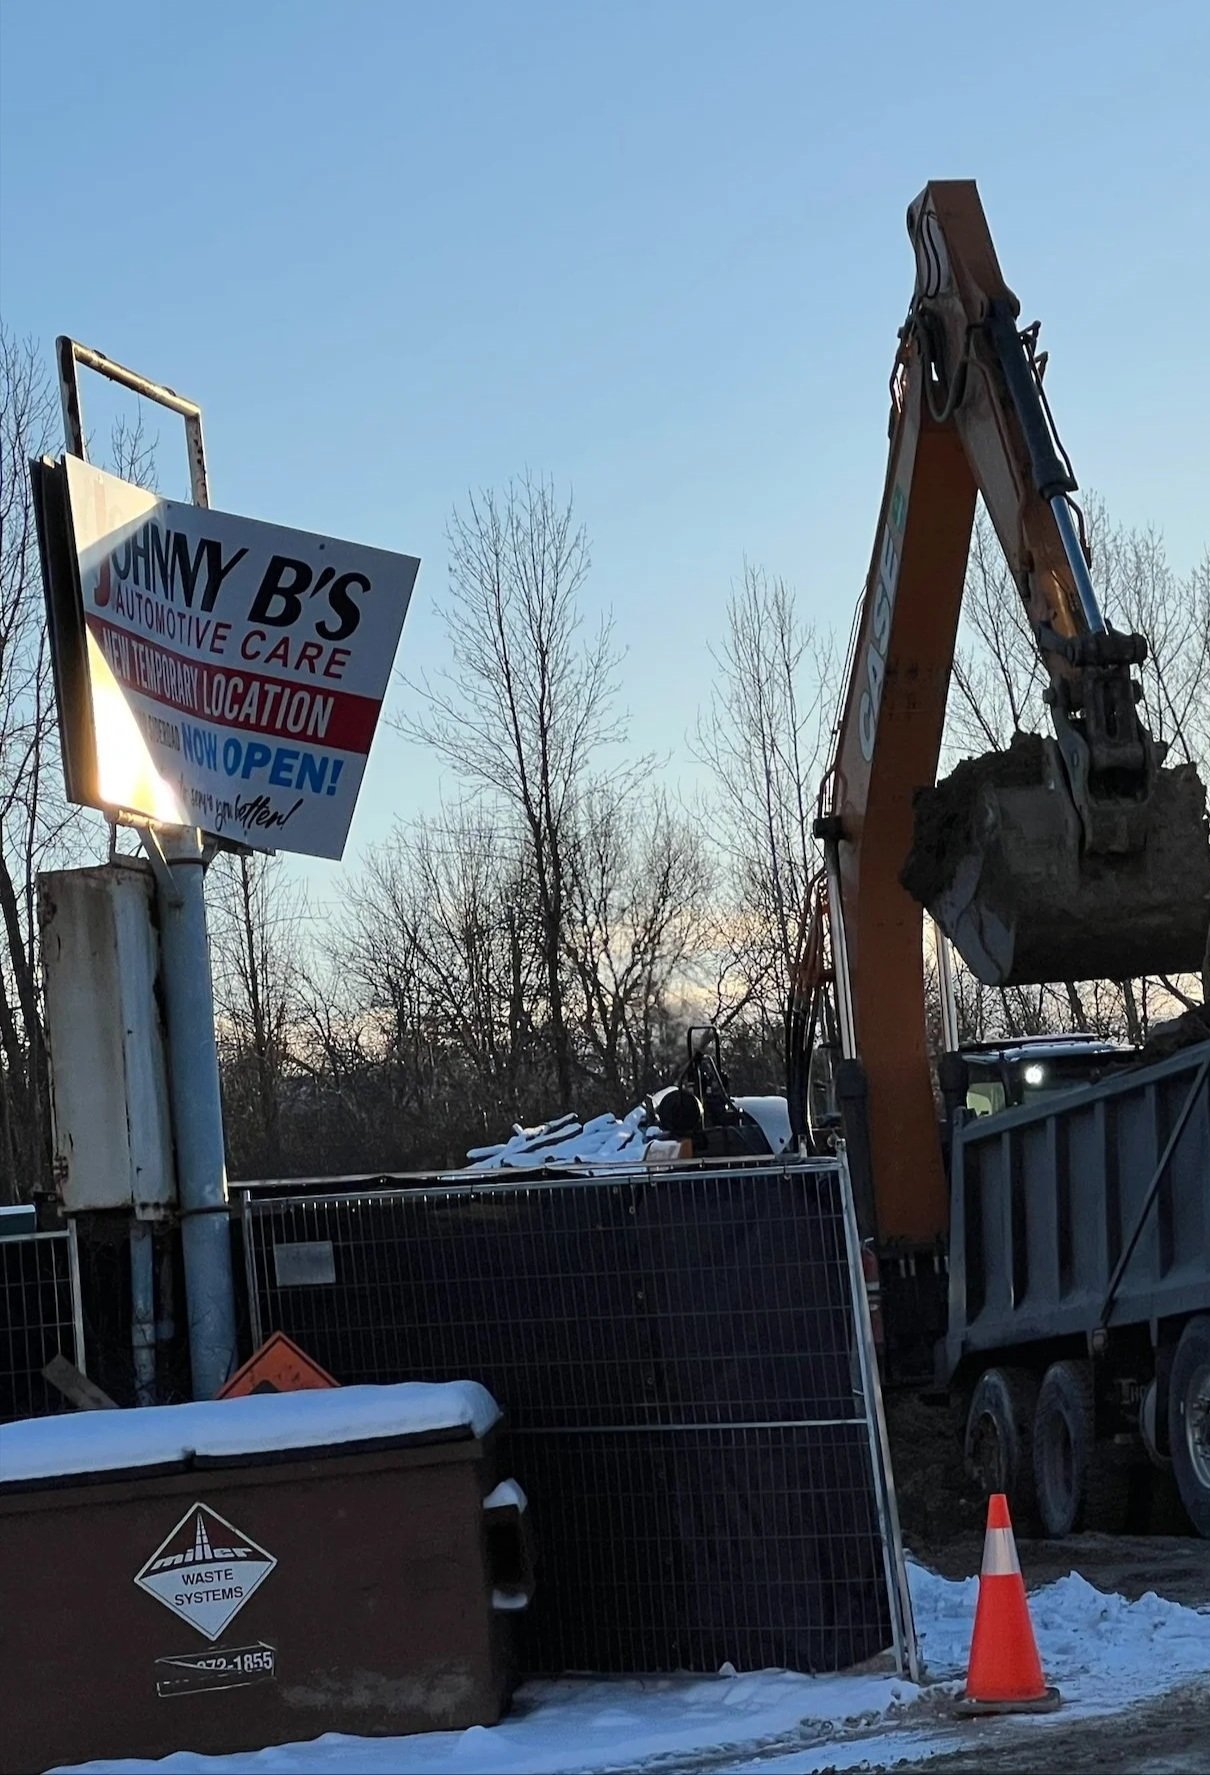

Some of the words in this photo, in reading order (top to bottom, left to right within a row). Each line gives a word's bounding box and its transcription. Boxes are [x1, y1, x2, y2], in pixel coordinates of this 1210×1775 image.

[94, 479, 249, 613] JOHNNY
[247, 555, 372, 641] B'S
[115, 584, 232, 654] AUTOMOTIVE
[240, 629, 352, 680] CARE
[858, 522, 900, 763] CASE
[101, 627, 132, 685] NEW
[131, 640, 199, 711] TEMPORARY
[203, 669, 335, 738] LOCATION
[181, 722, 217, 772] NOW
[222, 737, 344, 796] OPEN!
[174, 1586, 244, 1606] SYSTEMS
[181, 1568, 234, 1586] WASTE
